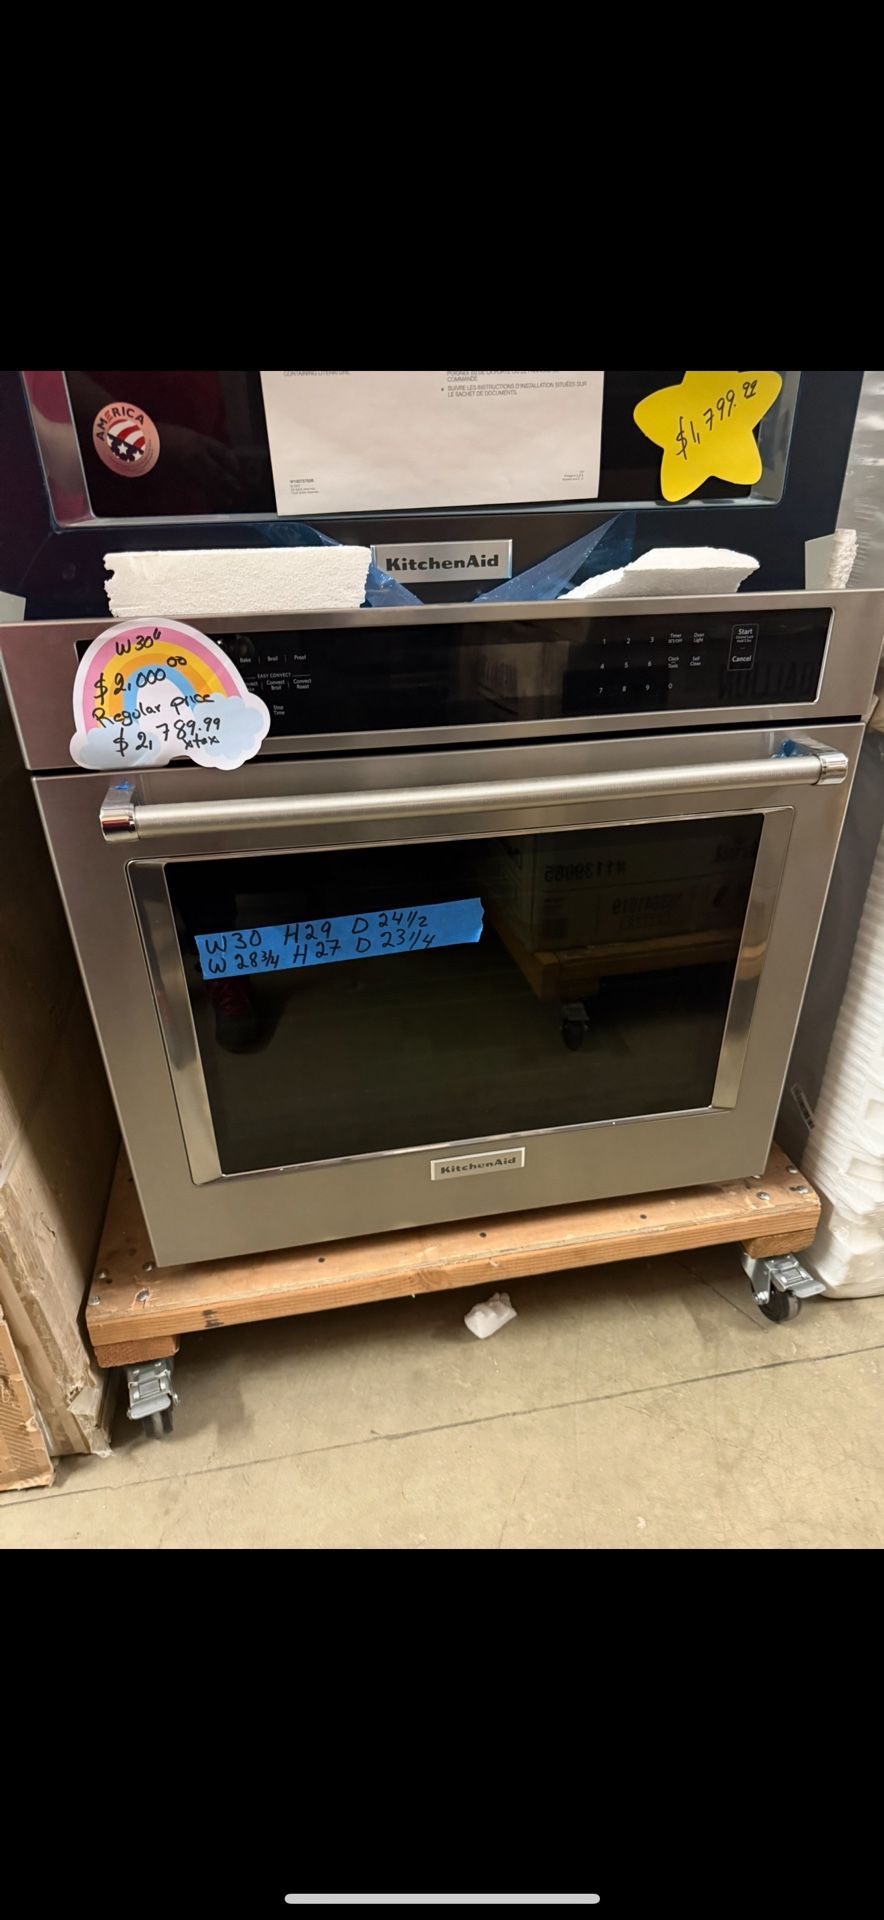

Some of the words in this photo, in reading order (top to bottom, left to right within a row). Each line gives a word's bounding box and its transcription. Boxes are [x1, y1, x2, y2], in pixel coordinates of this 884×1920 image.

[96, 406, 145, 442] AMERICA
[385, 554, 500, 572] KitchenAid
[626, 637, 631, 645] 2
[624, 661, 629, 669] 5
[731, 655, 752, 663] Cancel
[92, 706, 162, 729] Regular
[440, 1157, 517, 1175] KitchenAid
